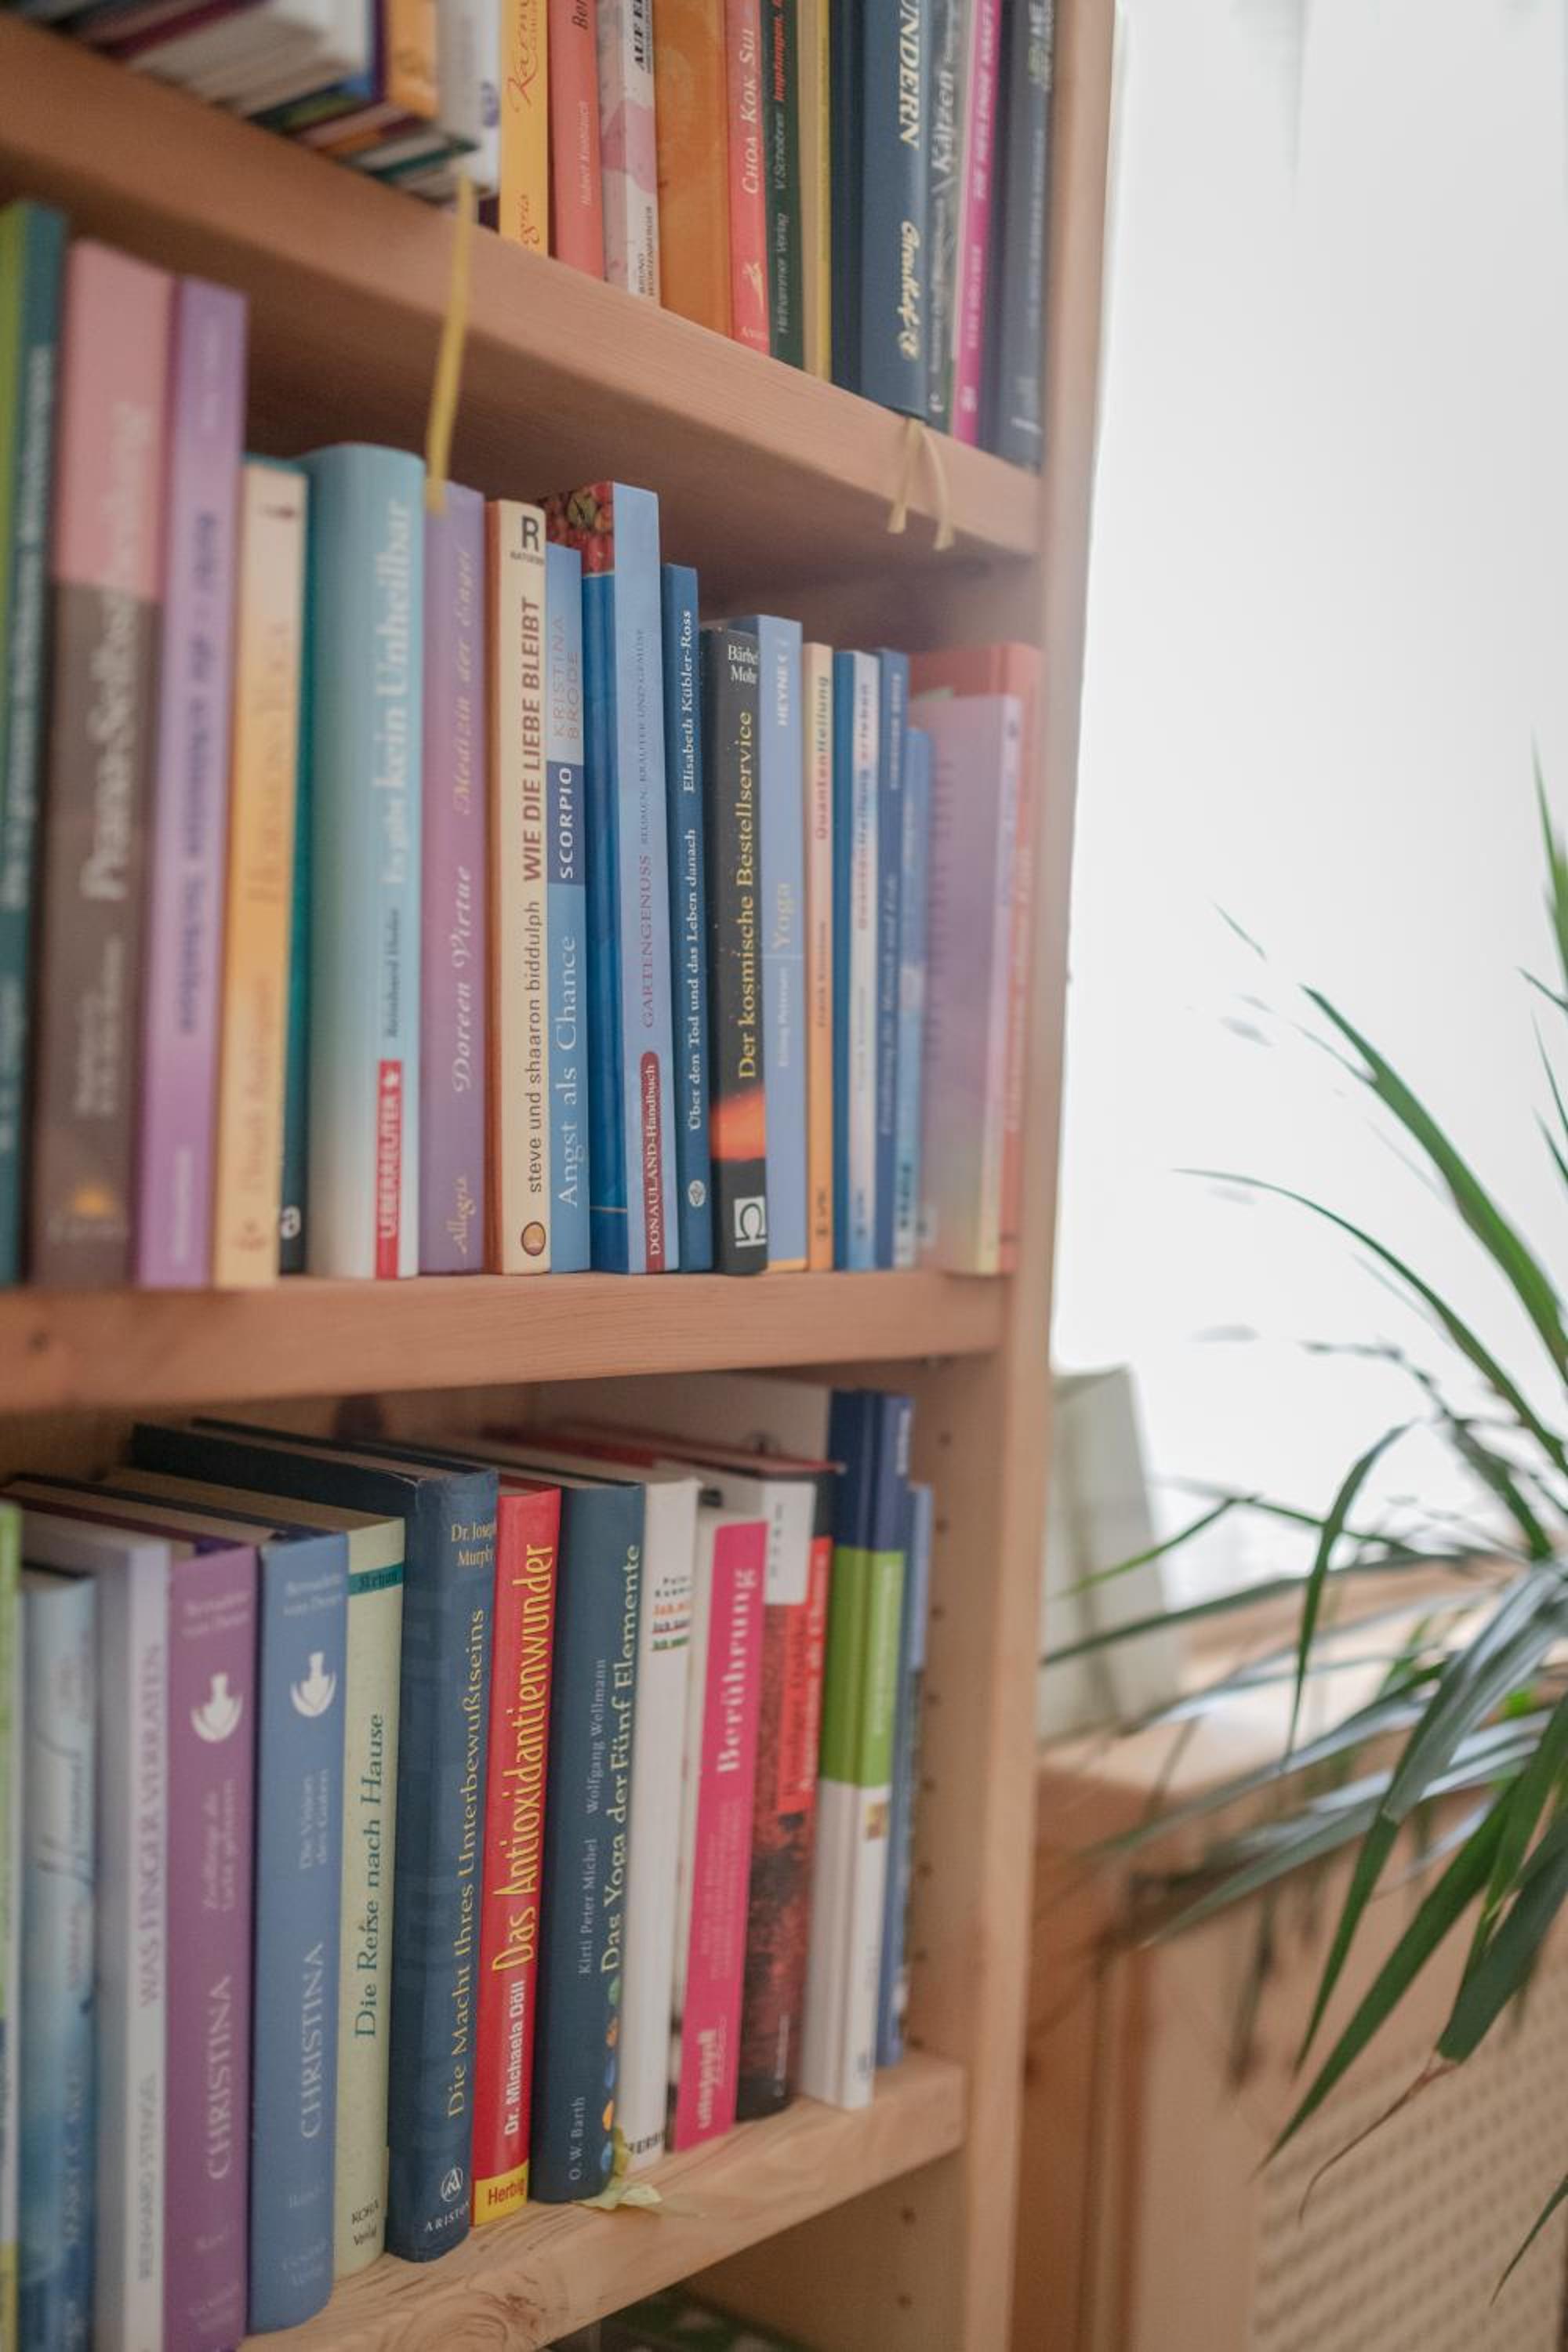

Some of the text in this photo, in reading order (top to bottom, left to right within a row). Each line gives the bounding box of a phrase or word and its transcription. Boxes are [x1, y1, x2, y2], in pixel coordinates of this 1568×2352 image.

[633, 23, 644, 71] AUF
[739, 27, 759, 194] CHOA KOK SUI
[375, 499, 410, 697] Unheilbar
[521, 516, 539, 552] R
[372, 707, 408, 789] kein
[451, 697, 473, 816] Medizin
[452, 639, 472, 683] der
[521, 595, 541, 881] WIE DIE LIEBE BLEIBT
[551, 615, 565, 738] KRISTINA
[681, 608, 695, 793] Elisabeth Kübler-Ross
[776, 663, 790, 728] HEYNE
[560, 767, 574, 880] SCORPIO
[735, 710, 756, 1079] Der kosmische Bestellservice
[771, 883, 796, 951] Yoga
[449, 865, 473, 1093] Doreen Virtue
[638, 854, 653, 1029] GARTENGENUSS
[684, 828, 701, 1131] Über den Tod und das Leben danach
[524, 901, 543, 1194] steve und shaaron biddulph
[555, 935, 583, 1210] Angst als Chance
[447, 1174, 475, 1256] Allegria
[644, 1064, 661, 1256] DONAULAND-Handbuch
[492, 1544, 554, 1971] Das Antioxidantienwunder
[601, 1544, 639, 1973] Das Yoga der Fünf Elemente
[716, 1566, 758, 1773] Berührung
[355, 1714, 383, 2038] Die Reise nach Hause
[448, 1609, 486, 2118] Die Macht Ihres Unterbewußtseins
[579, 1659, 607, 1974] Kirti Peter Michel Wolfgang Wellmann
[206, 1975, 232, 2180] CHRISTINA
[302, 1941, 324, 2139] CHRISTINA
[504, 1980, 524, 2135] Dr. Michaela Döll
[568, 2096, 586, 2181] O. W. Barth
